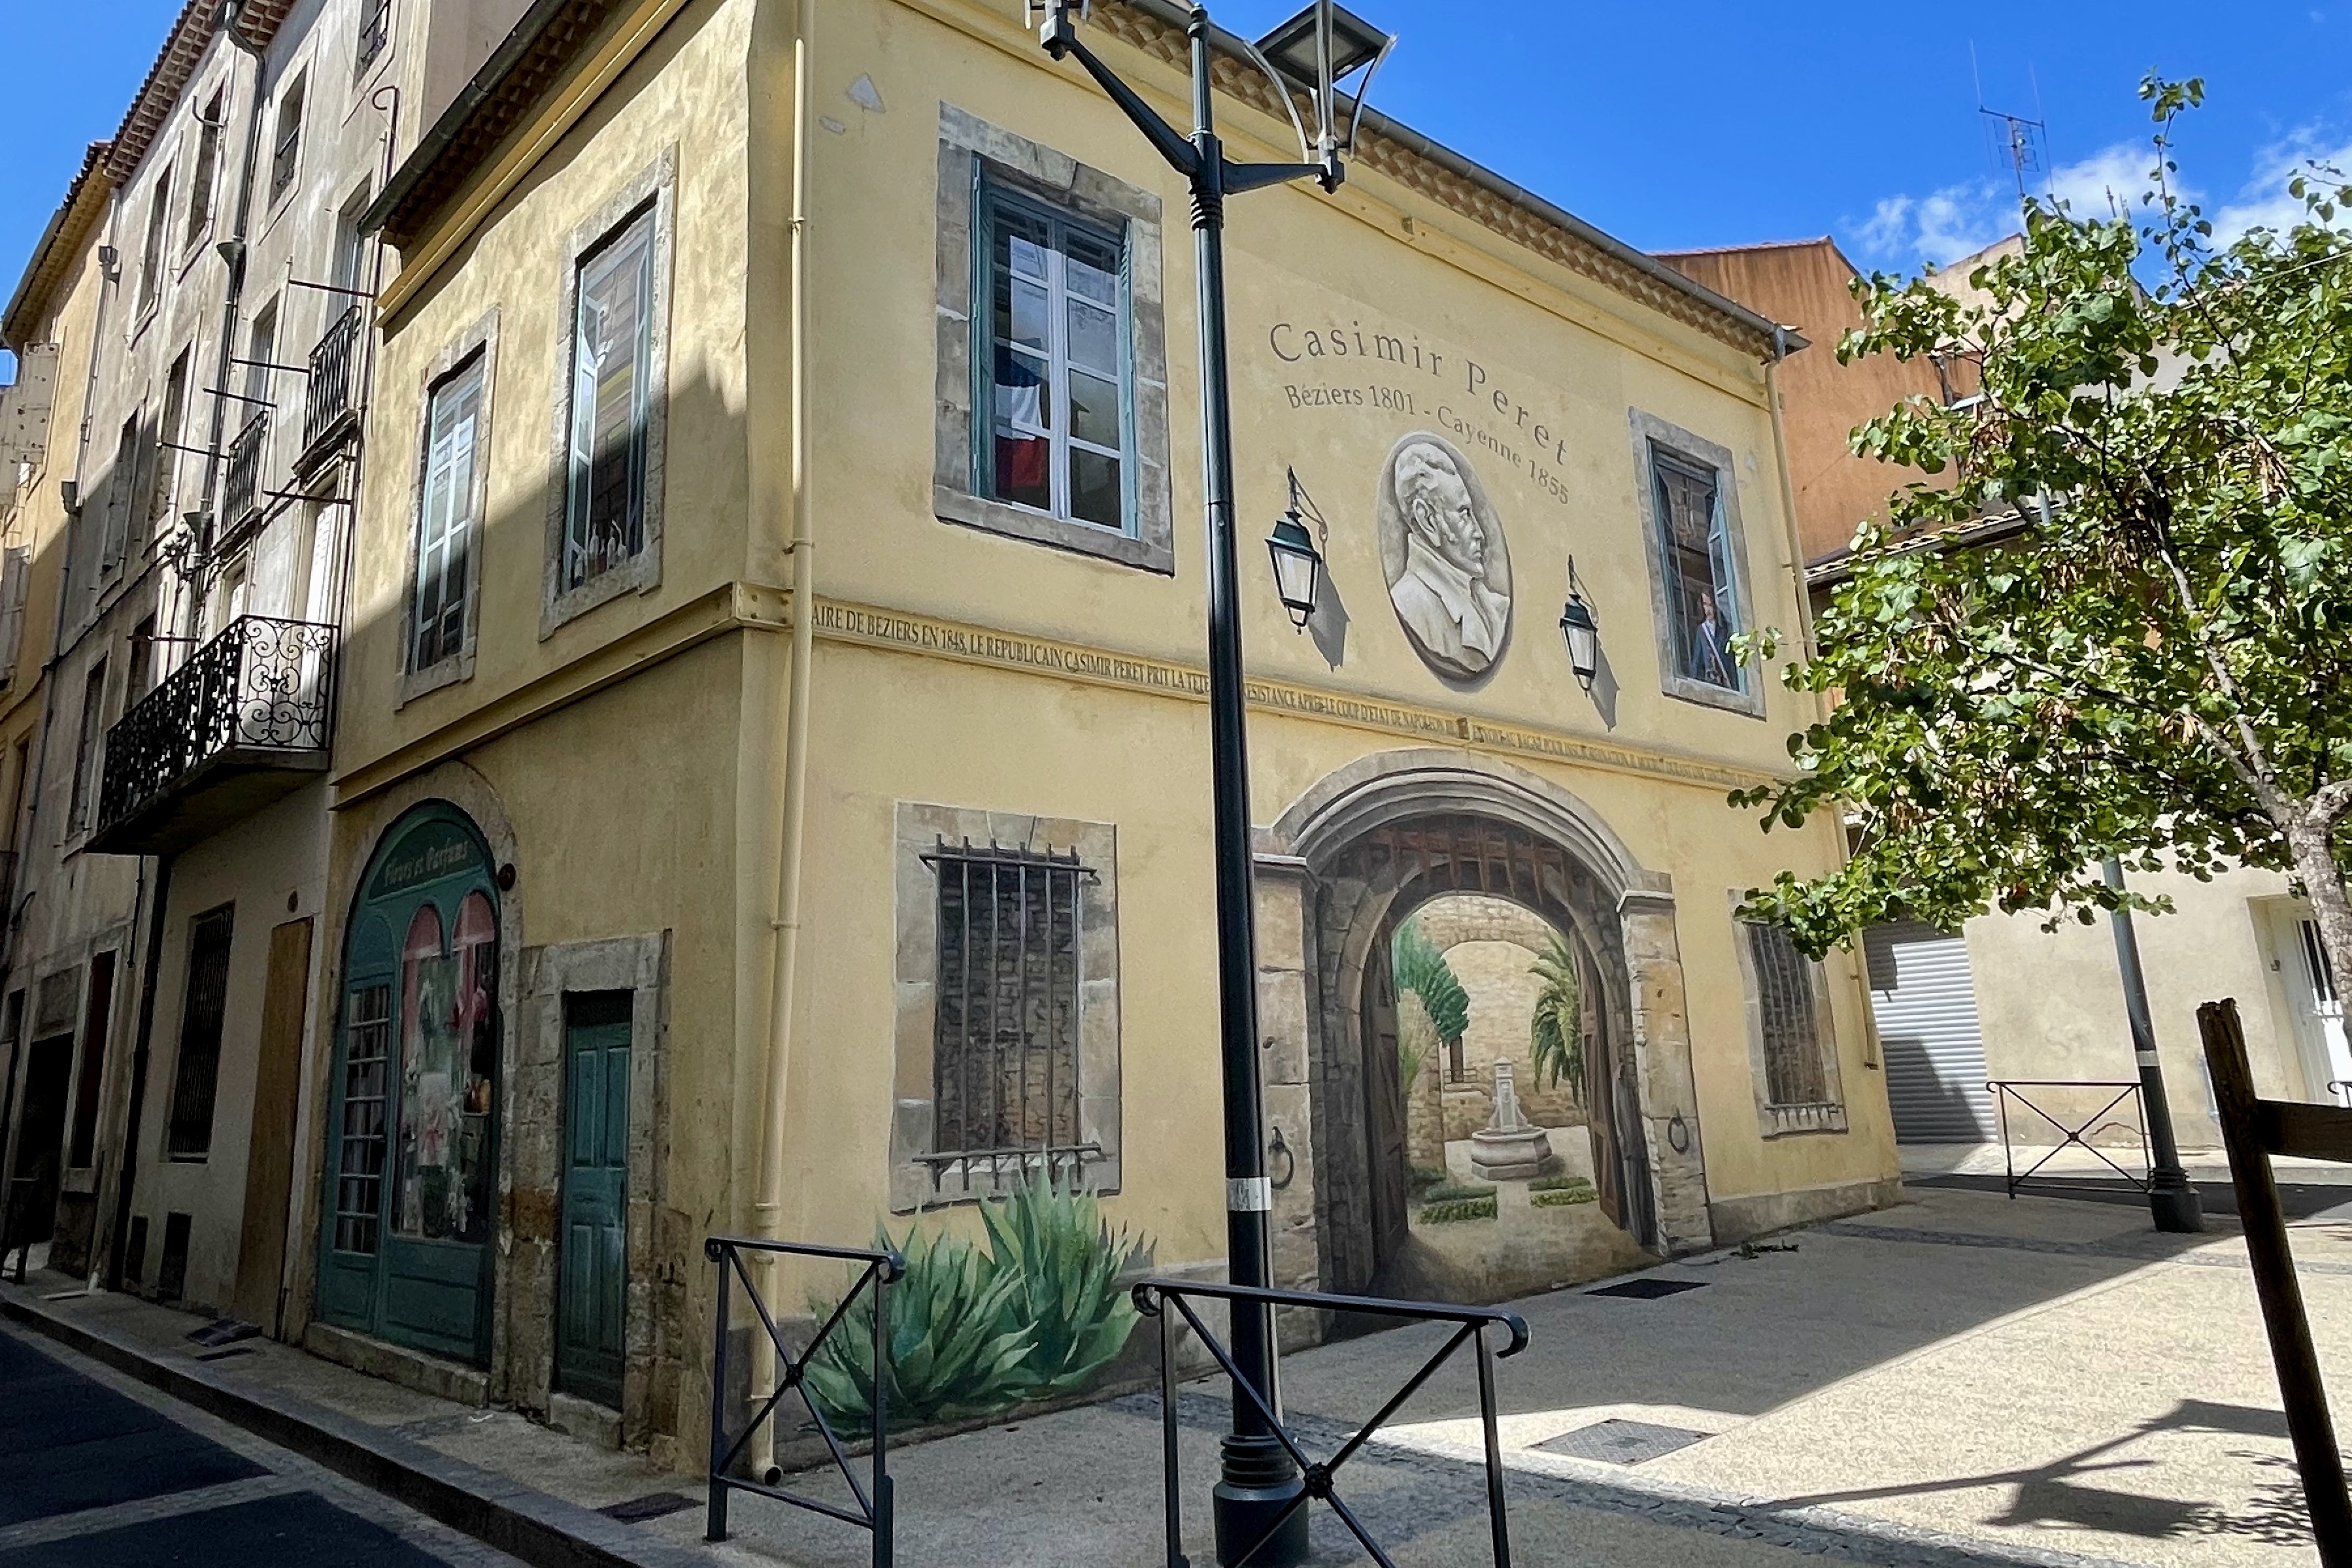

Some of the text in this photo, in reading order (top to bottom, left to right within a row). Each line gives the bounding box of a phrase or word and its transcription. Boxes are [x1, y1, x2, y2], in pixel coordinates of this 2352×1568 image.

[1270, 321, 1567, 465] Casimir Peret
[1285, 382, 1363, 409] Béziers
[1369, 386, 1415, 415] 1801
[1438, 406, 1521, 467] Cayenne
[1528, 459, 1568, 505] 1855
[811, 604, 842, 629] AIRE
[847, 610, 864, 633] DE
[867, 614, 918, 642] BEZIERS
[922, 625, 939, 646] EN
[971, 634, 983, 654] LE
[986, 637, 1062, 667] REPUBLICAIN
[1065, 652, 1112, 676] CASIMIR
[1245, 683, 1296, 709] ESISTANCE
